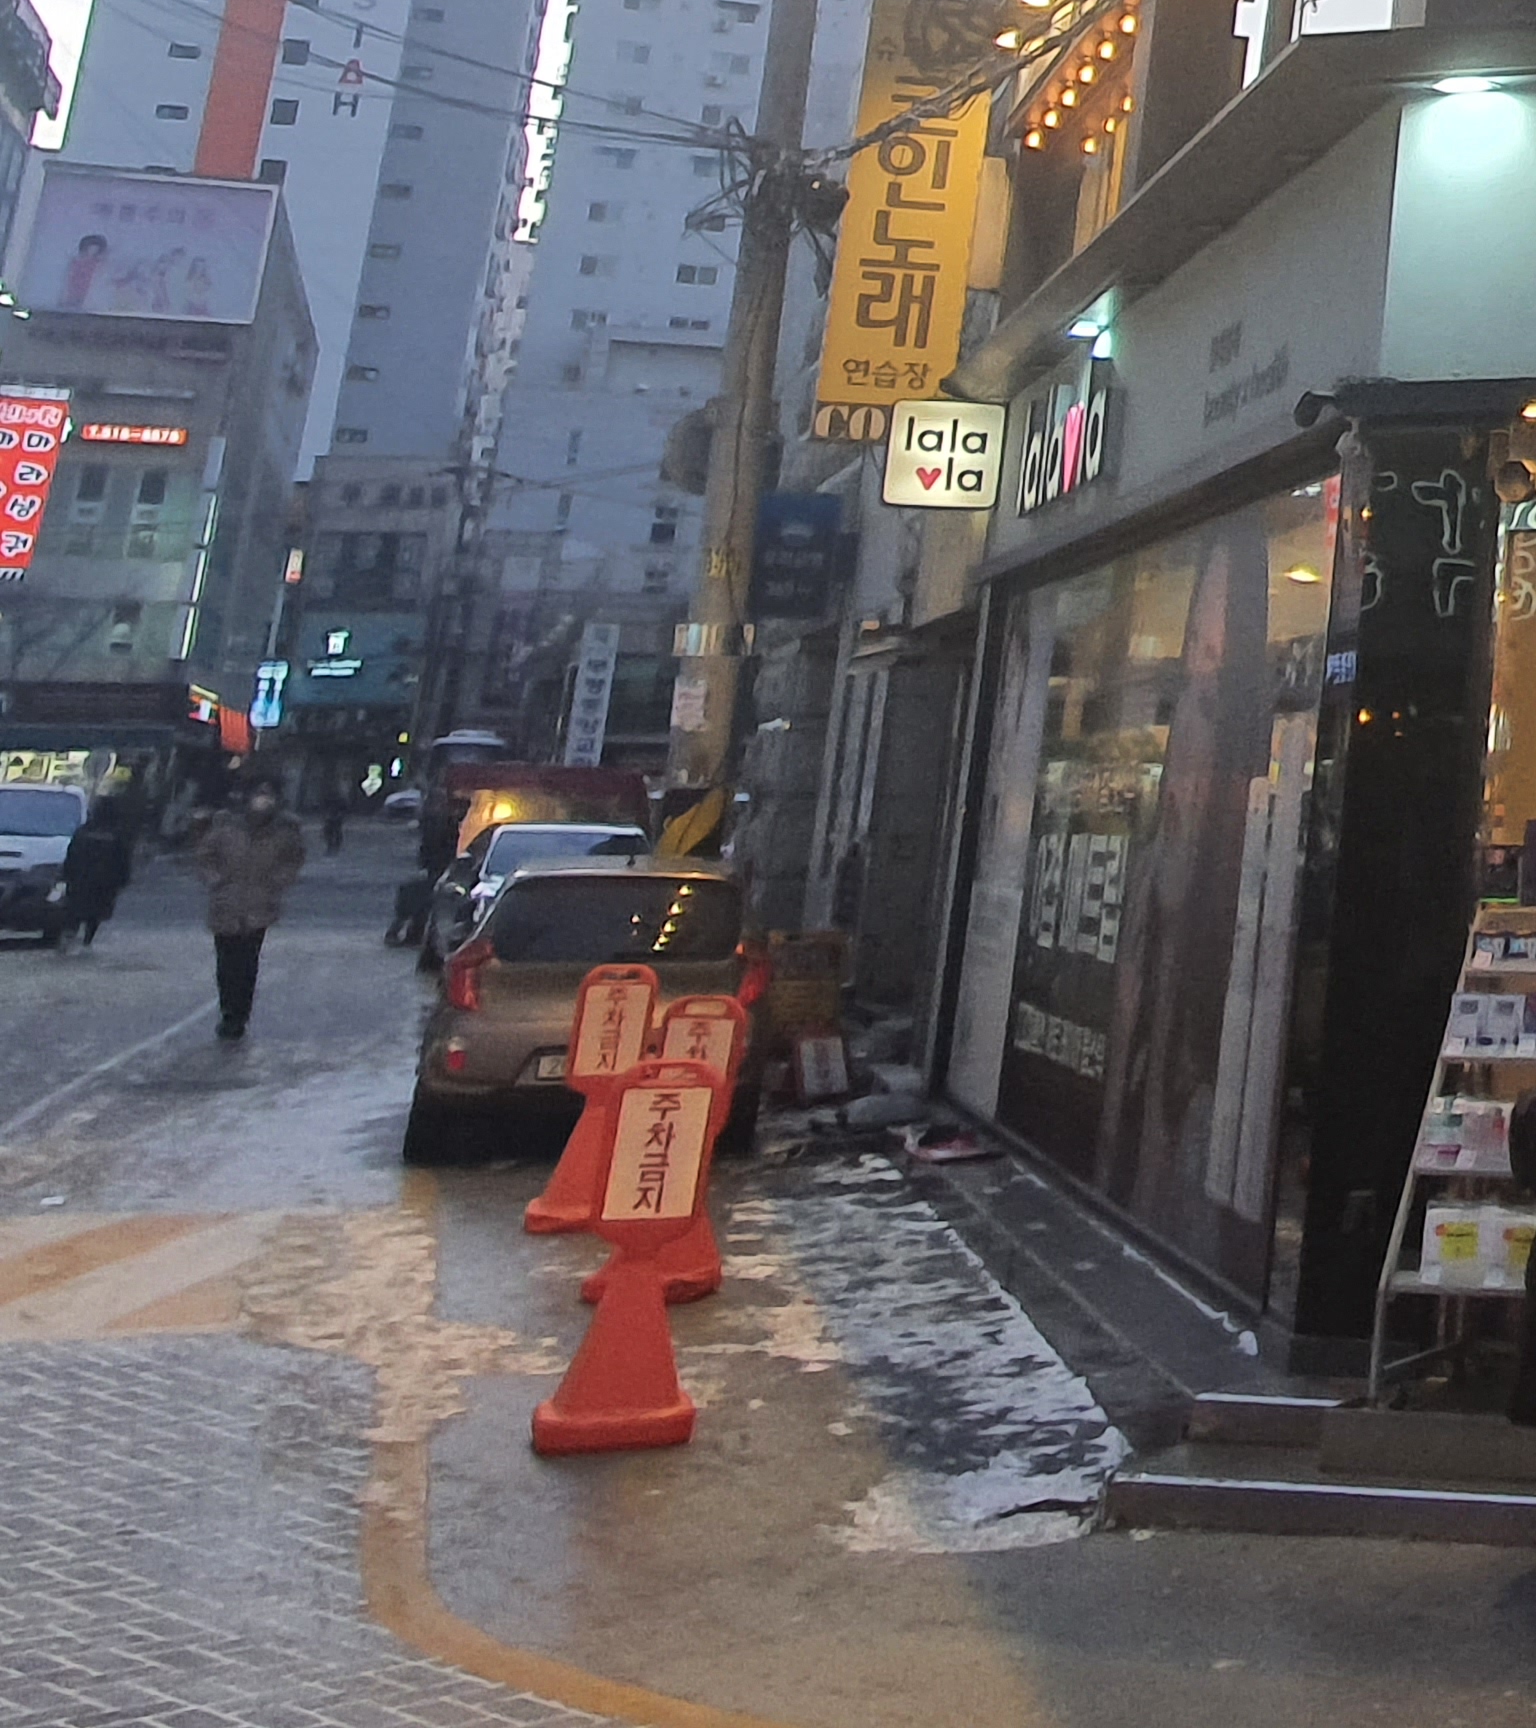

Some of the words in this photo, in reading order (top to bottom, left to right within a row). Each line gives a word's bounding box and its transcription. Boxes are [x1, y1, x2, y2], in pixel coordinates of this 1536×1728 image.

[841, 358, 932, 392] 연습장
[905, 416, 988, 455] lala
[597, 985, 628, 1072] 주차금지
[632, 1092, 680, 1215] 주차금지
